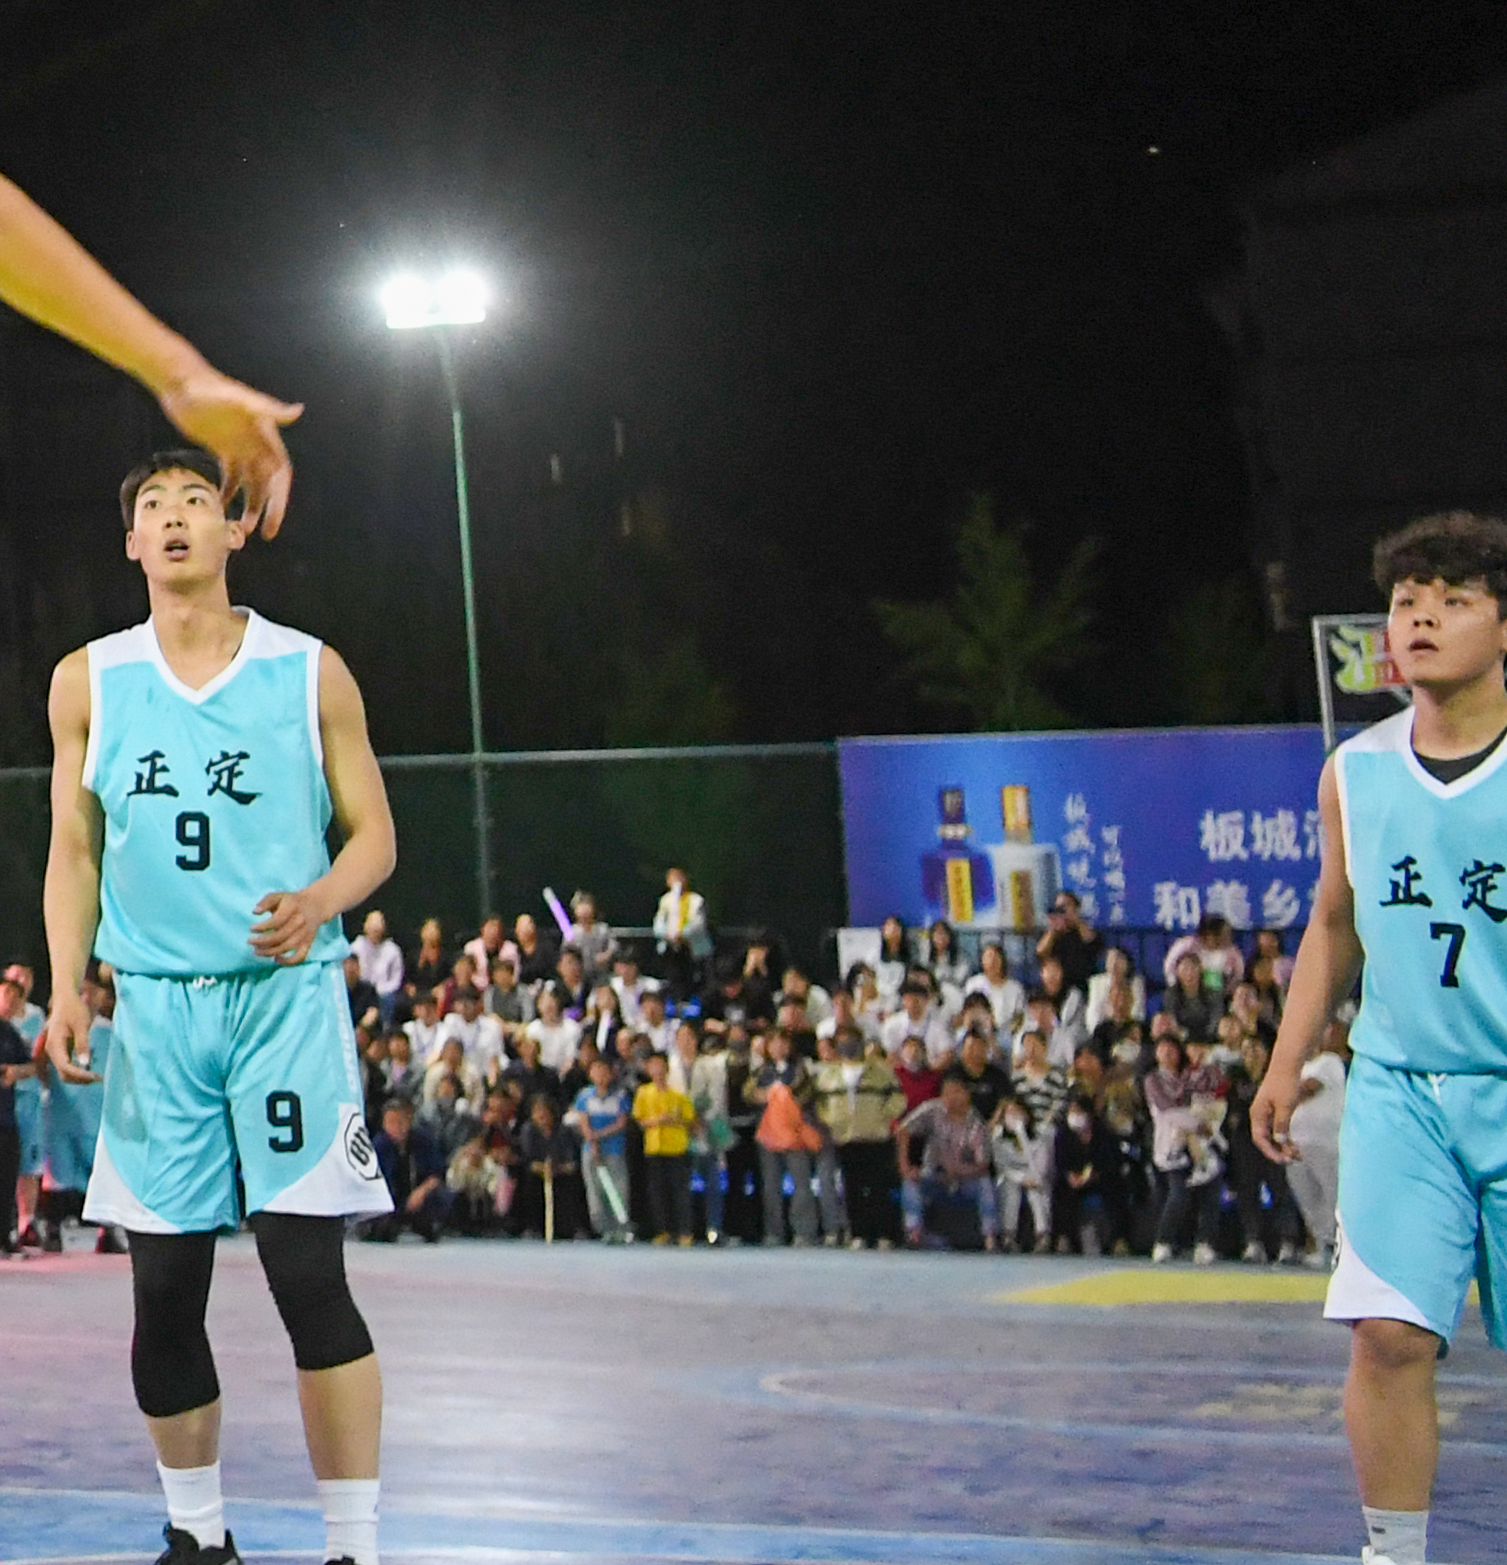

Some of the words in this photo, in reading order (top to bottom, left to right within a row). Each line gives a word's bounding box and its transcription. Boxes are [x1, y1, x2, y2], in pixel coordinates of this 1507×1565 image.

[127, 750, 261, 806] 正定
[175, 812, 211, 872] 9
[1379, 855, 1507, 923] 正定
[1429, 922, 1466, 988] 7
[265, 1090, 304, 1153] 9
